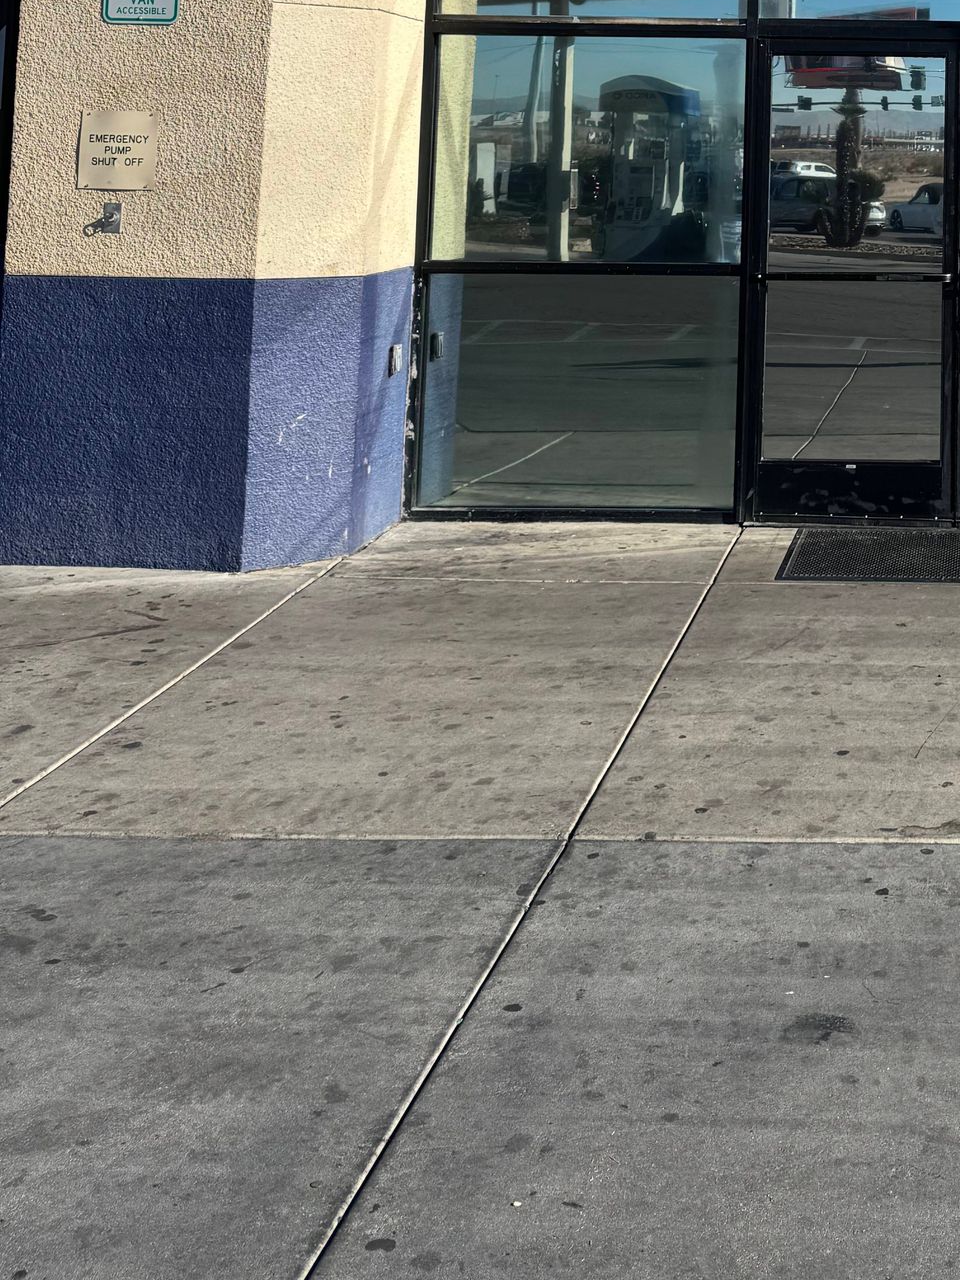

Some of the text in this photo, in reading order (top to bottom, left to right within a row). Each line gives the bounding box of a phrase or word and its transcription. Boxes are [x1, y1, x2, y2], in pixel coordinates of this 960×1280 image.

[116, 7, 167, 15] ACCESSIBLE
[89, 134, 149, 143] EMERGENCY
[104, 146, 132, 155] PUMP
[91, 157, 144, 167] SHUT OFF
